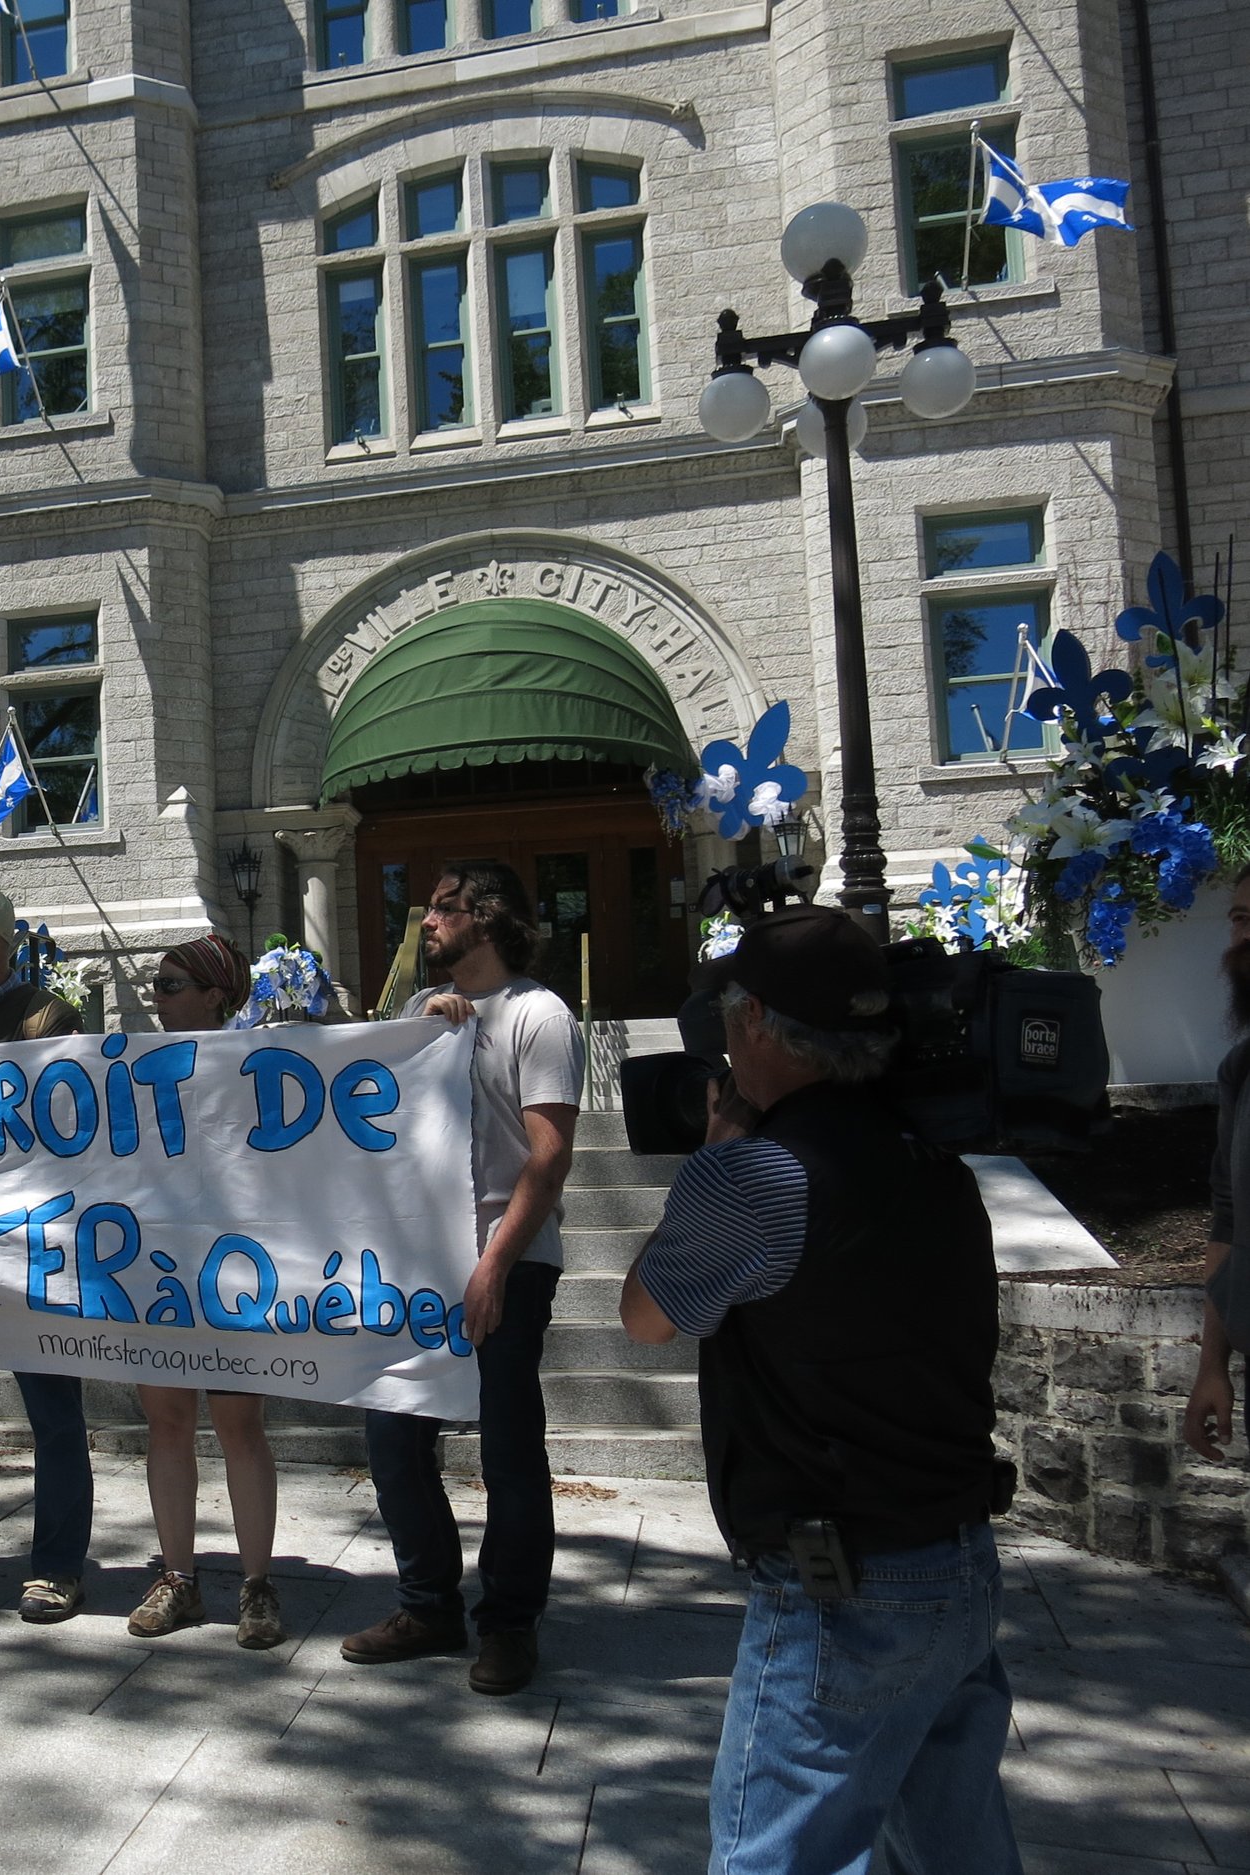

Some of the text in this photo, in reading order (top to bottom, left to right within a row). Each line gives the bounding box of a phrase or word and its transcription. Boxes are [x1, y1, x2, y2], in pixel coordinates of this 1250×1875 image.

[326, 645, 354, 676] DE
[344, 570, 459, 655] VILLE
[1024, 1040, 1055, 1056] brace
[1025, 1026, 1056, 1042] porta
[145, 1250, 196, 1328] à
[198, 1233, 474, 1357] Québec
[37, 1332, 320, 1386] manifesteraquebec.org
